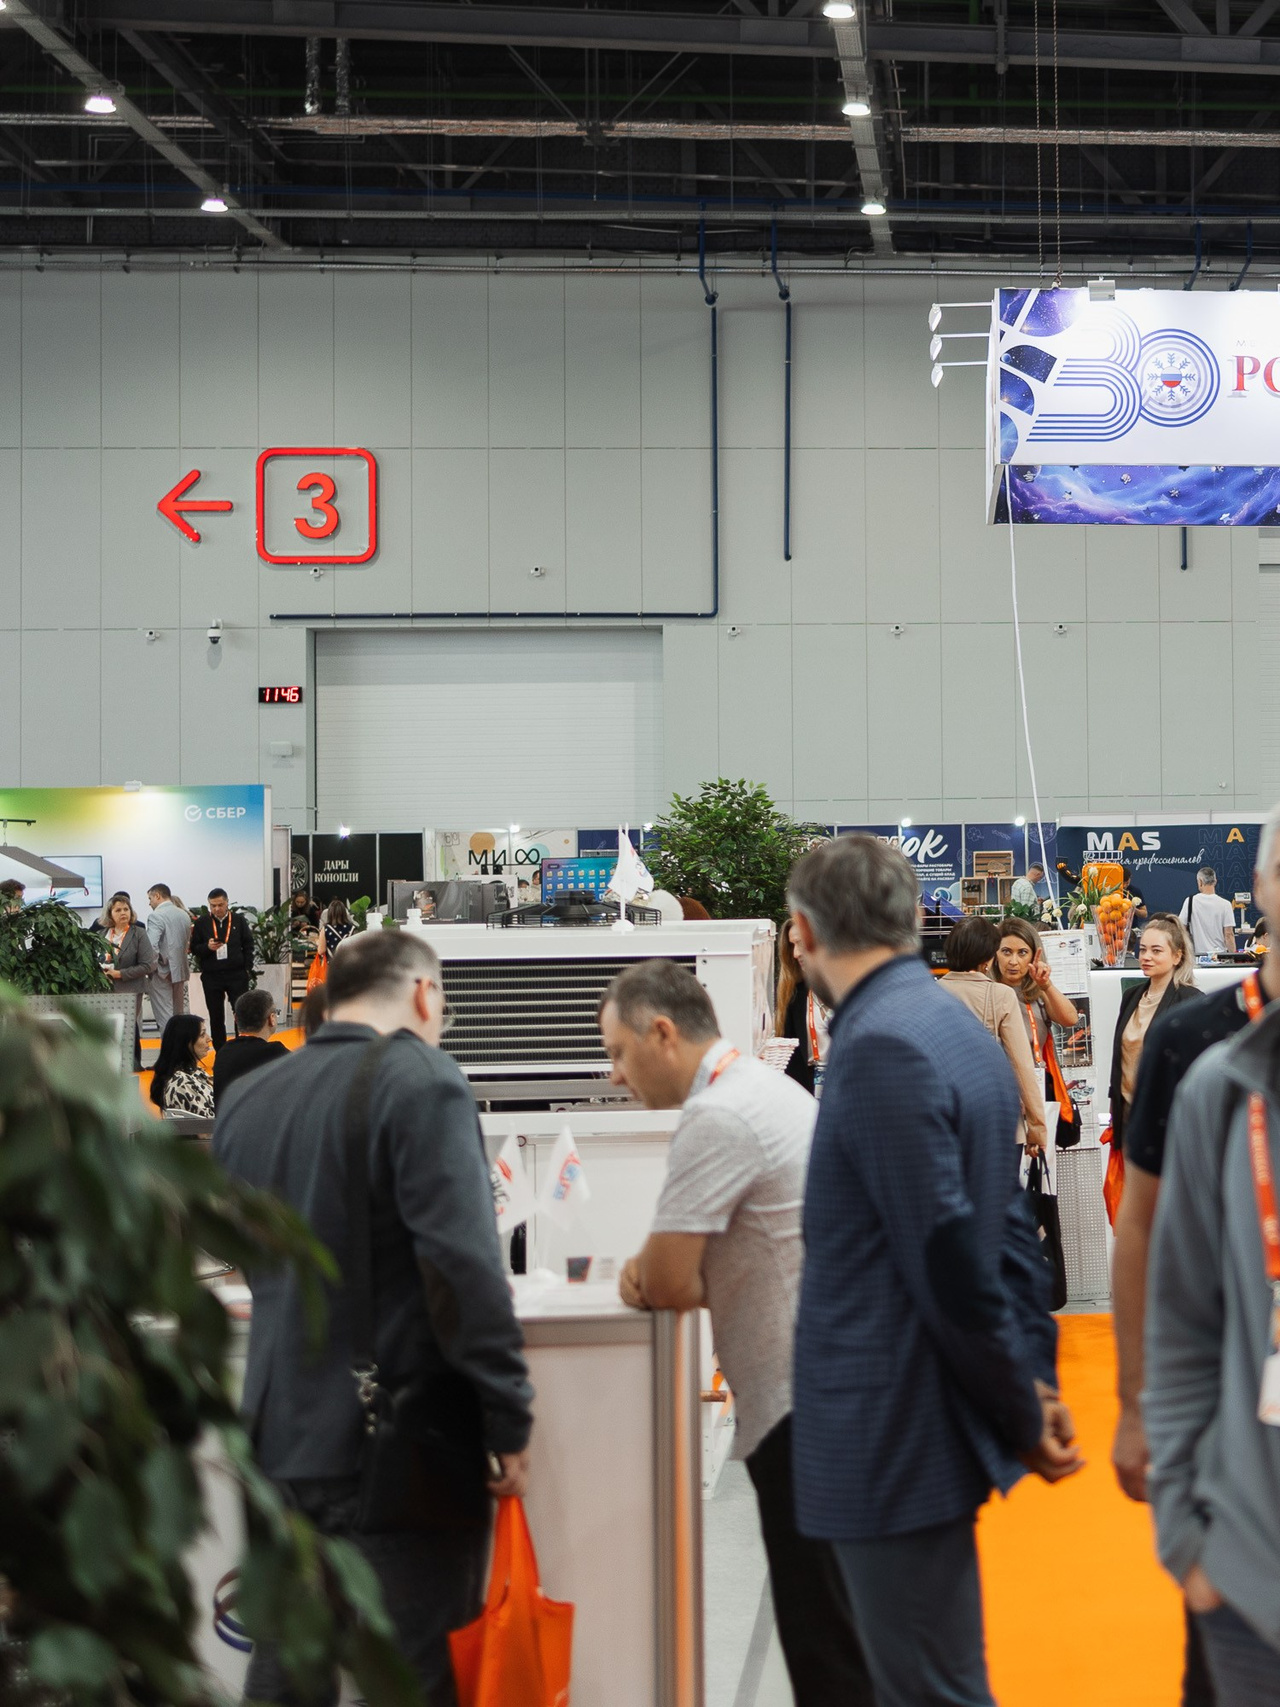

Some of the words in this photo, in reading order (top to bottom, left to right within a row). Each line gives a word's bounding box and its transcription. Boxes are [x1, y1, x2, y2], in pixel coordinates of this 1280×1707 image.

[294, 472, 340, 539] 3
[205, 806, 247, 819] СБЕР
[1086, 831, 1161, 851] MAS
[323, 859, 350, 872] ДАРЫ
[1132, 848, 1204, 872] профессионалов
[314, 872, 359, 883] КОНОПЛИ
